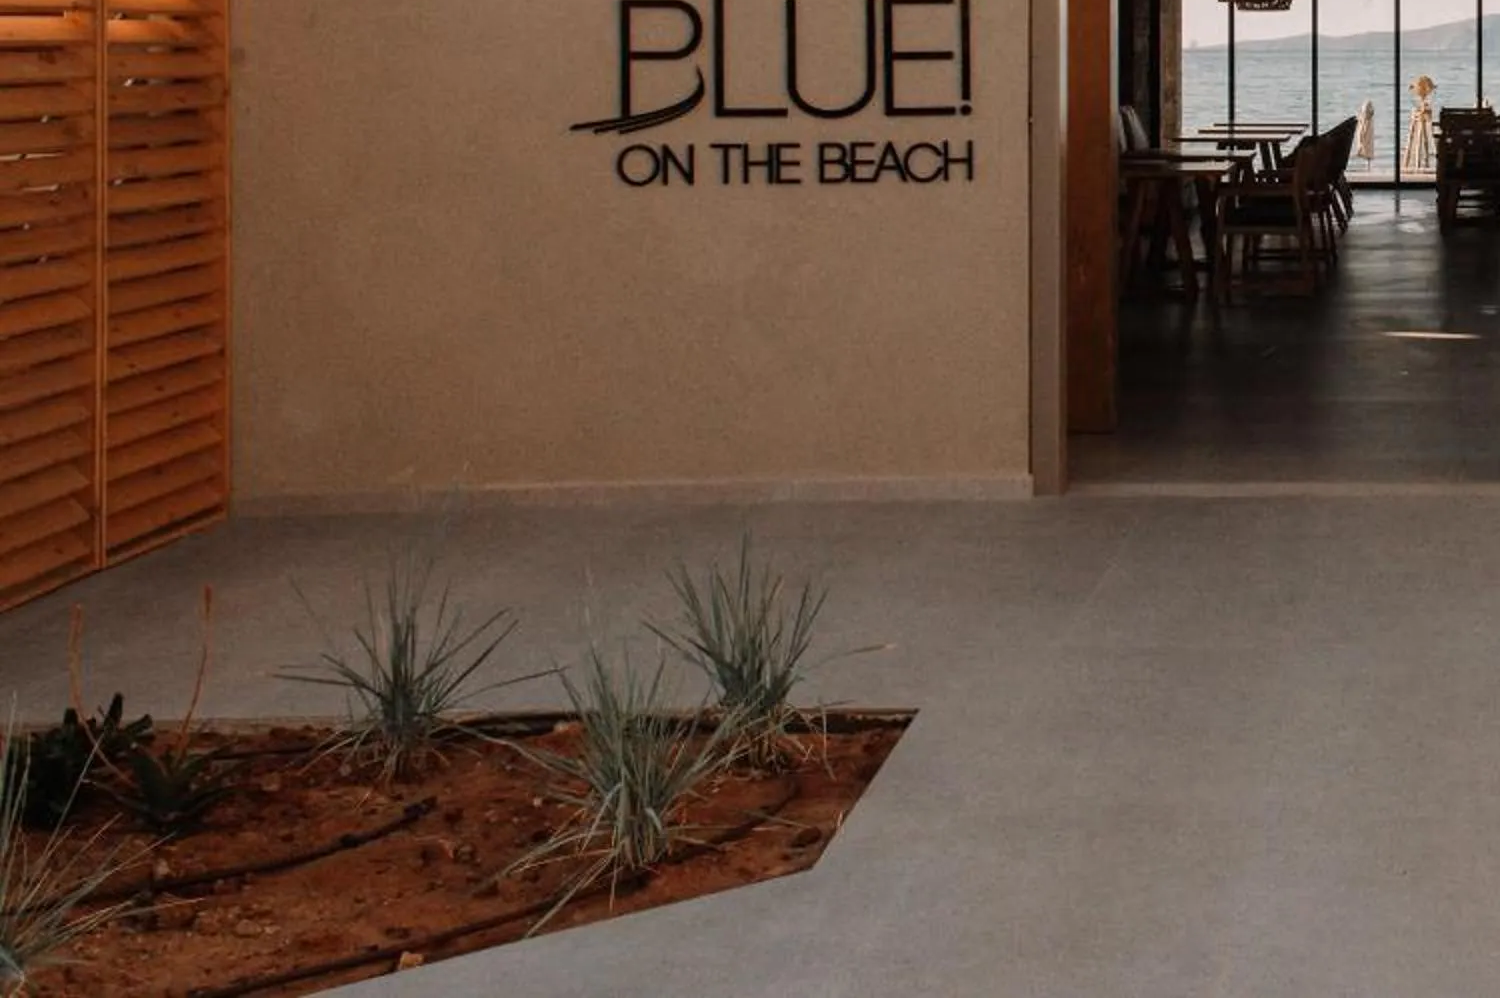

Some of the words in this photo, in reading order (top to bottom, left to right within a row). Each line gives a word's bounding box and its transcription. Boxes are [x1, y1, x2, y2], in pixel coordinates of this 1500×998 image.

[616, 143, 695, 187] ON
[709, 142, 802, 185] THE
[817, 139, 974, 185] BEACH
